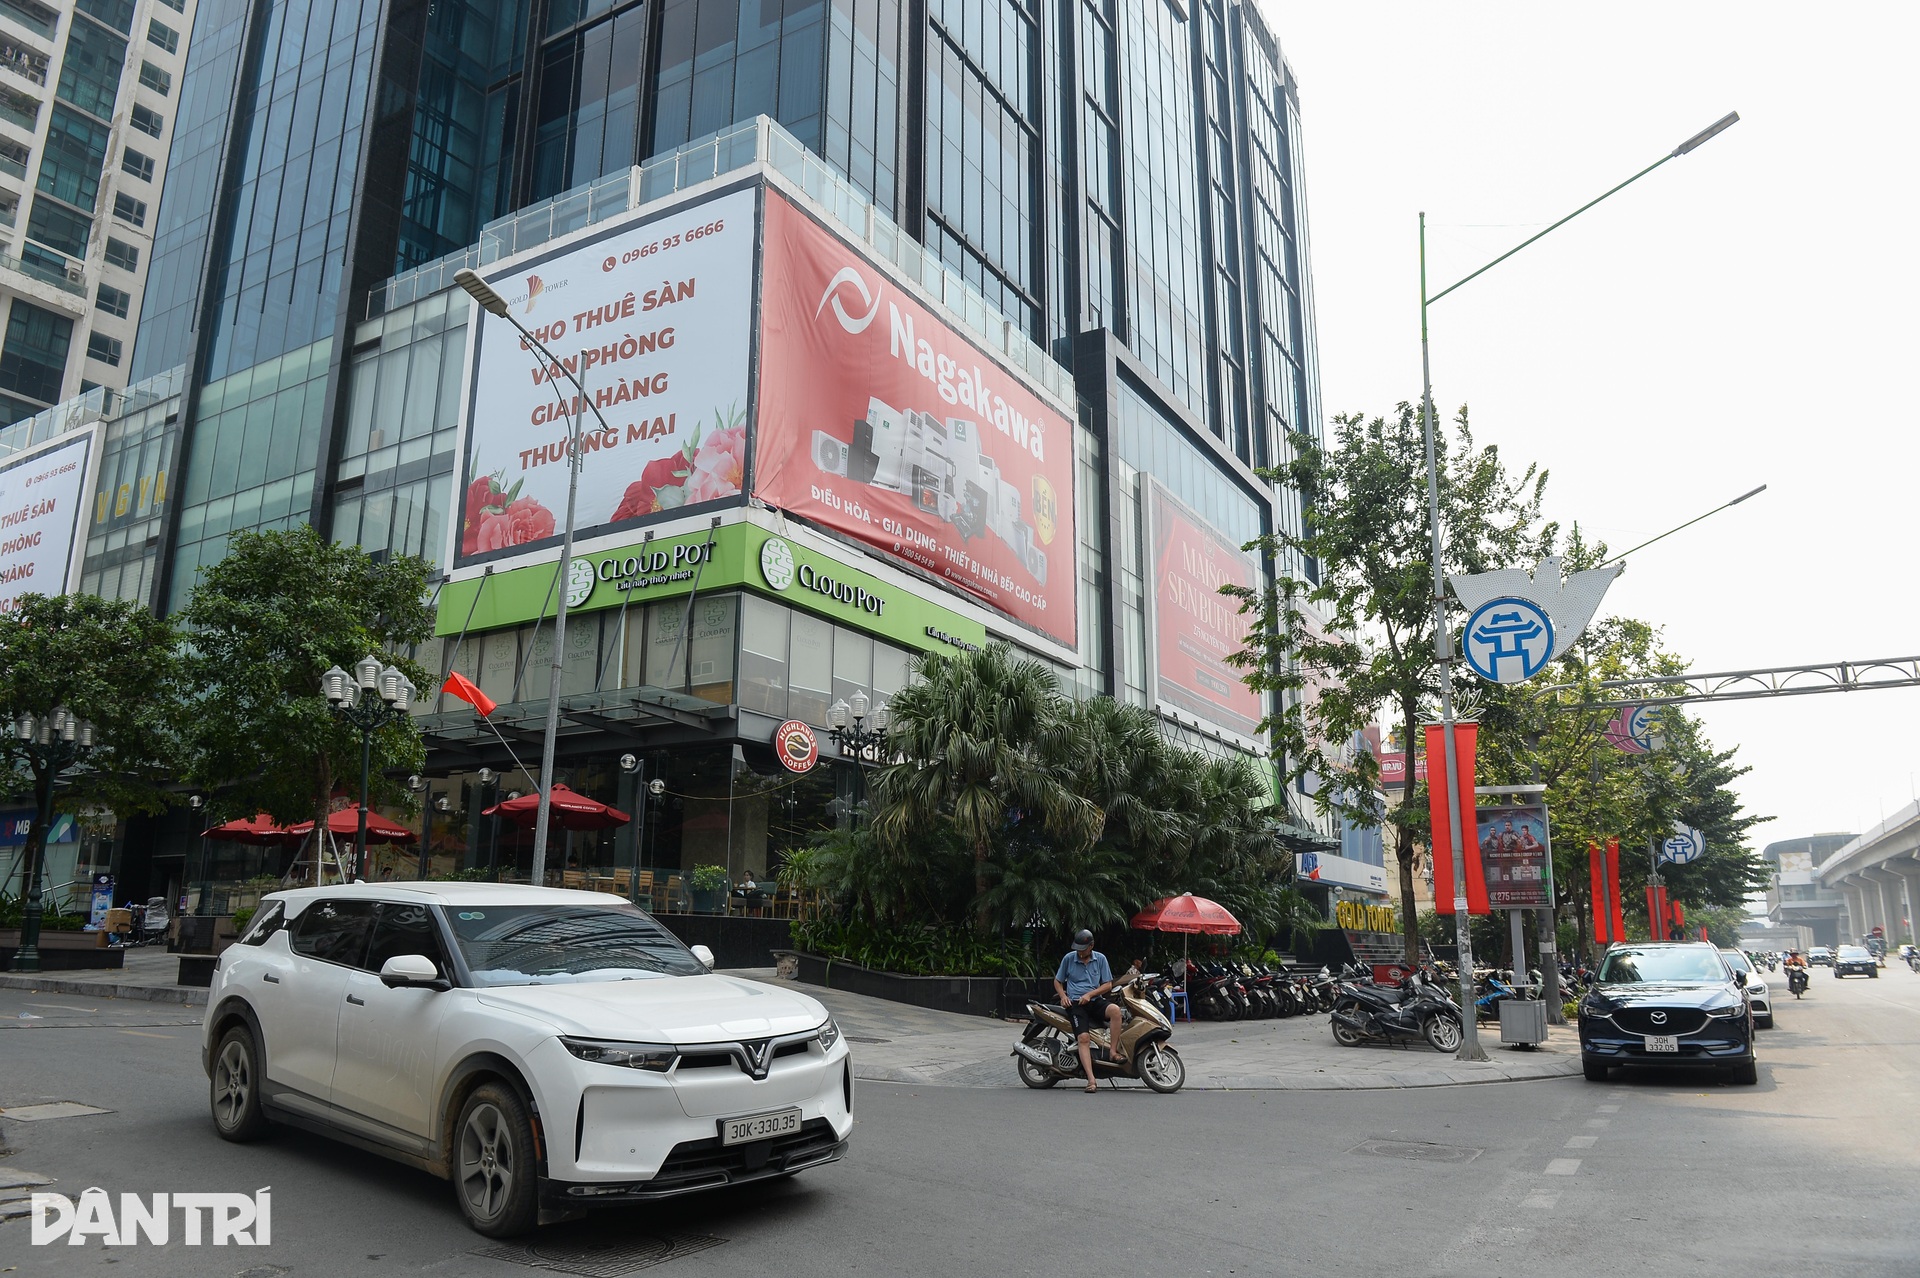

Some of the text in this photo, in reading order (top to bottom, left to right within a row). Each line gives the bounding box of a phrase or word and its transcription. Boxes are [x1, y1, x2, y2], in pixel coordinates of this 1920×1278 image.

[621, 219, 724, 264] 0966 93 6666
[510, 279, 568, 306] GOLD TOWER
[519, 278, 695, 351] CHO THUÊ SÀN
[586, 327, 675, 369] PHÒNG
[596, 372, 668, 411] HÀNG
[889, 301, 1044, 463] Nagakawa
[626, 413, 676, 444] MẠI
[59, 462, 77, 475] 6666
[1, 498, 56, 529] THUÊ SÀN
[1, 531, 42, 556] PHÒNG
[811, 485, 841, 510] ĐIỀU
[844, 500, 871, 524] HÒA
[882, 517, 902, 537] GIA
[906, 526, 936, 552] DỤNG
[944, 545, 970, 573] THIẾT
[971, 560, 980, 579] BỊ
[981, 565, 998, 586] NHÀ
[1000, 575, 1015, 593] BẾP
[1015, 585, 1030, 603] CAO
[1032, 595, 1047, 610] CẤP
[597, 541, 716, 581] CLOUD POT
[1182, 542, 1237, 605] MAISON
[799, 564, 885, 616] CLOUD POT
[1168, 571, 1249, 645] SEN BUFFET
[779, 723, 815, 748] HIGHLANDS
[783, 754, 812, 770] COFFEE
[15, 820, 30, 835] MB
[1497, 891, 1510, 901] 275
[1336, 899, 1395, 933] GOLD TOWER
[1654, 1036, 1669, 1044] 30H
[731, 1114, 796, 1139] 30K-330.35
